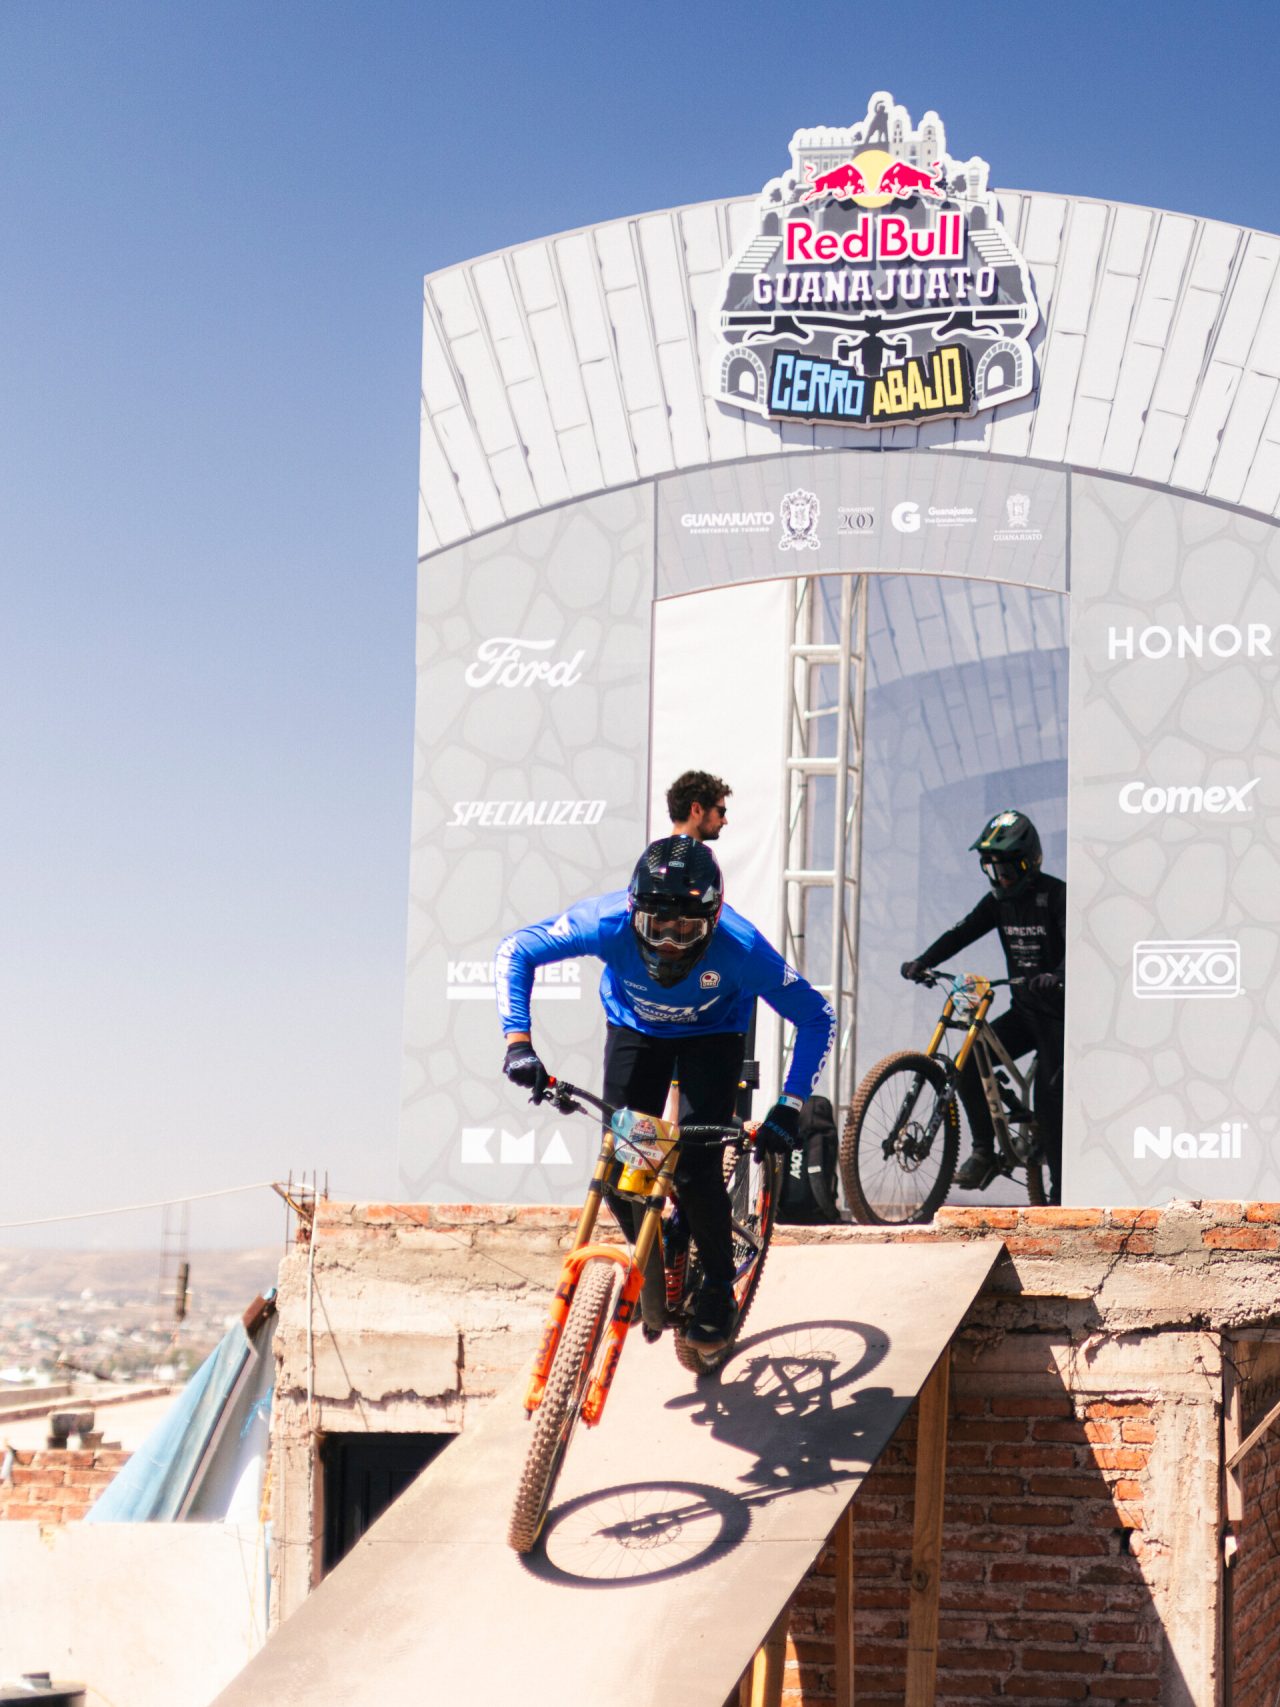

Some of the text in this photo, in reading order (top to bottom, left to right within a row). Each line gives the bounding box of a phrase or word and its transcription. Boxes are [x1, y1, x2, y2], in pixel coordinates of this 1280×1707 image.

[786, 214, 960, 261] Red Bull
[753, 268, 995, 304] GUANAJUATO
[771, 353, 865, 417] CERRO
[872, 347, 964, 416] ABAJO
[681, 512, 774, 527] GUANAJUATO
[927, 506, 974, 517] Guanajuato
[1108, 623, 1273, 660] HONOR
[464, 637, 586, 689] Ford
[446, 799, 607, 827] SPECIALIZED
[1118, 776, 1262, 815] Comex
[447, 961, 581, 983] KÄER
[1136, 952, 1236, 987] OXXO
[461, 1127, 573, 1165] KMA
[1133, 1122, 1242, 1160] Nazil
